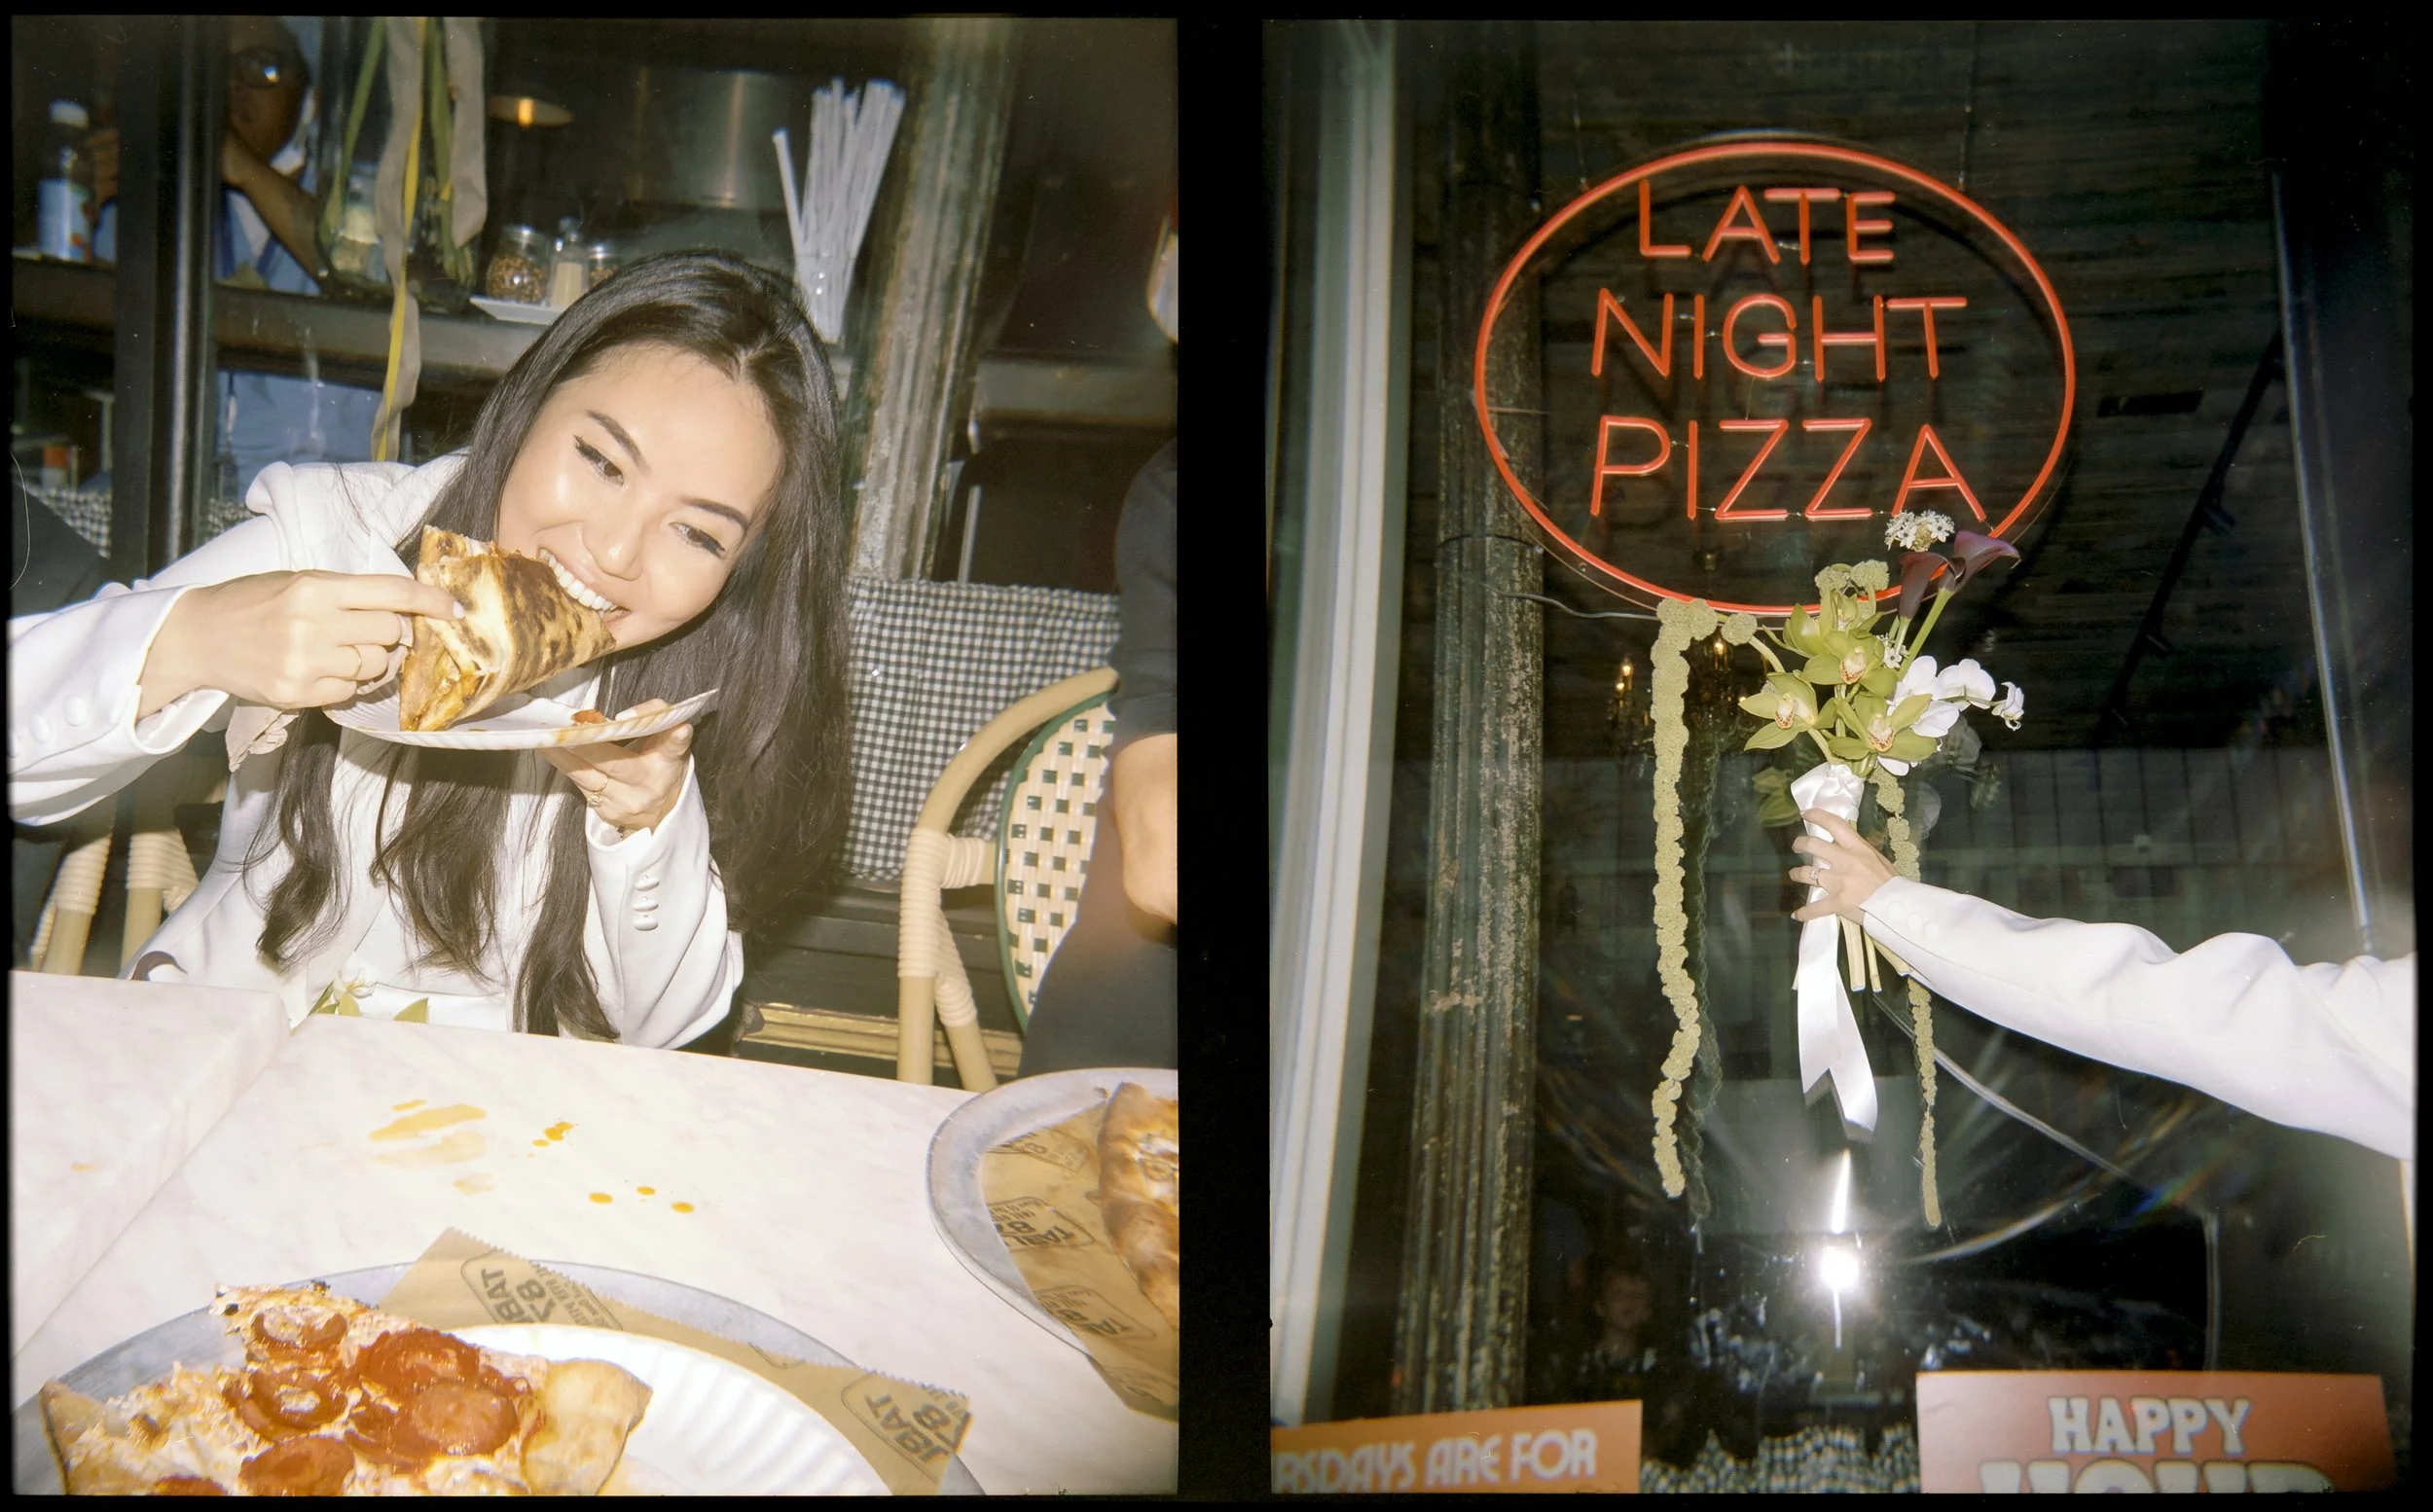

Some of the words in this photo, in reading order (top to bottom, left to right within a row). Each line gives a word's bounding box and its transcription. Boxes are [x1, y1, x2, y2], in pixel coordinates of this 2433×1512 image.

[1639, 179, 1896, 266] LATE
[1591, 287, 1968, 382] NIGHT
[1590, 414, 1986, 522] PIZZA
[1424, 1433, 1504, 1491] ARE
[1509, 1427, 1598, 1483] FOR
[2048, 1395, 2252, 1456] HAPPY
